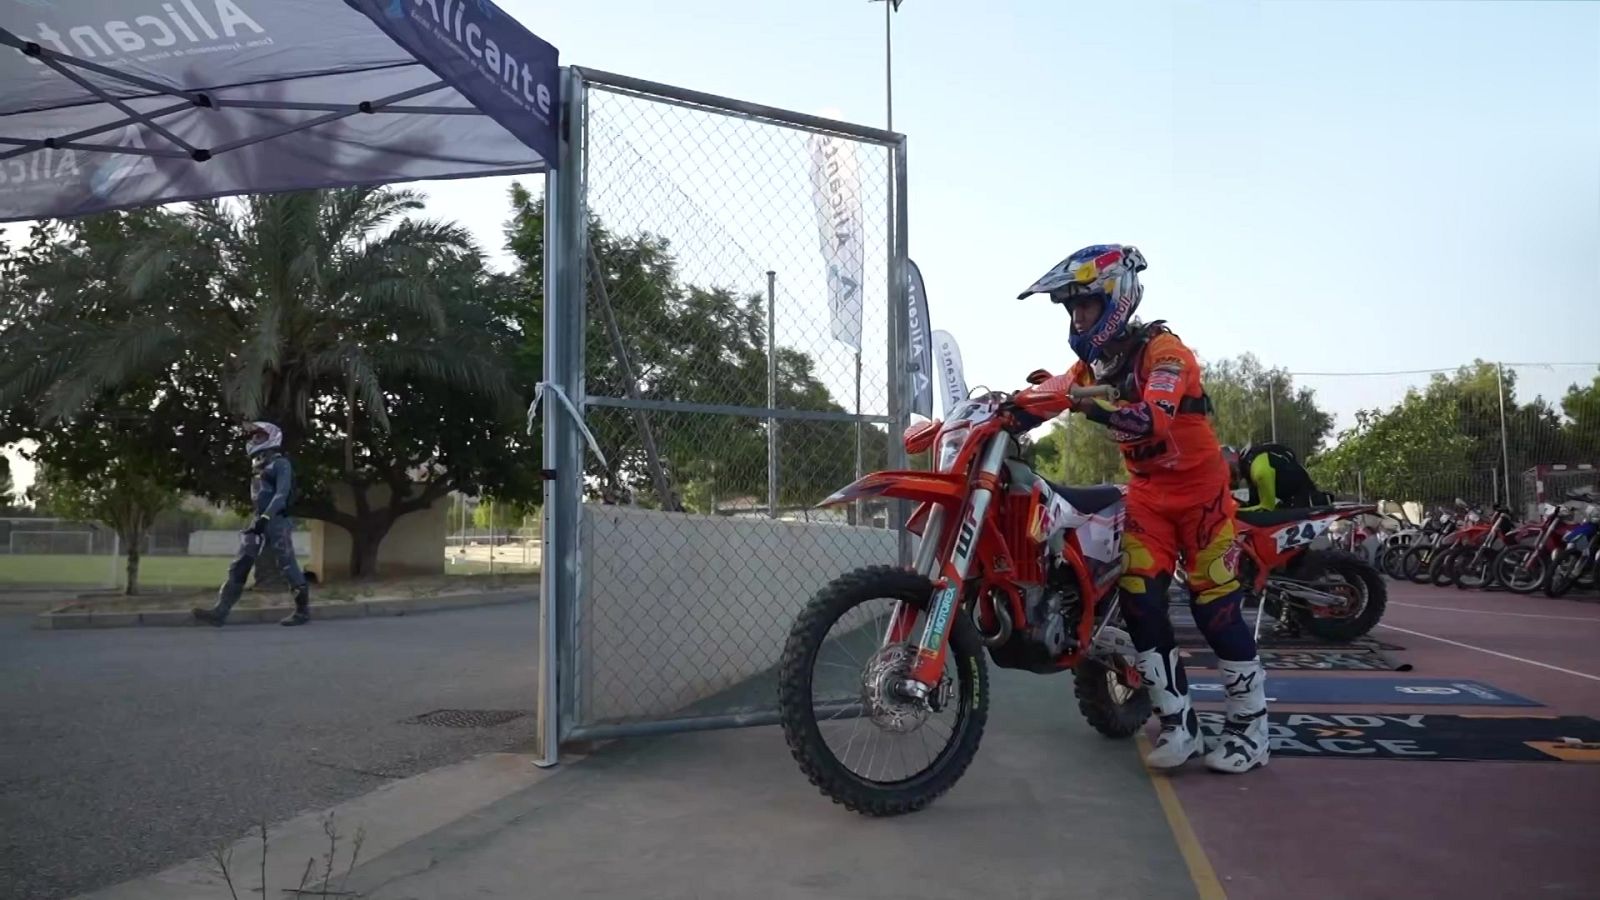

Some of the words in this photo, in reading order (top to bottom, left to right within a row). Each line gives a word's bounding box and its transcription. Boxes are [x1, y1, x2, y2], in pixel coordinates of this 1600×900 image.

[1284, 522, 1316, 546] 24
[934, 587, 956, 635] MOTOREX
[1196, 711, 1426, 728] RADY
